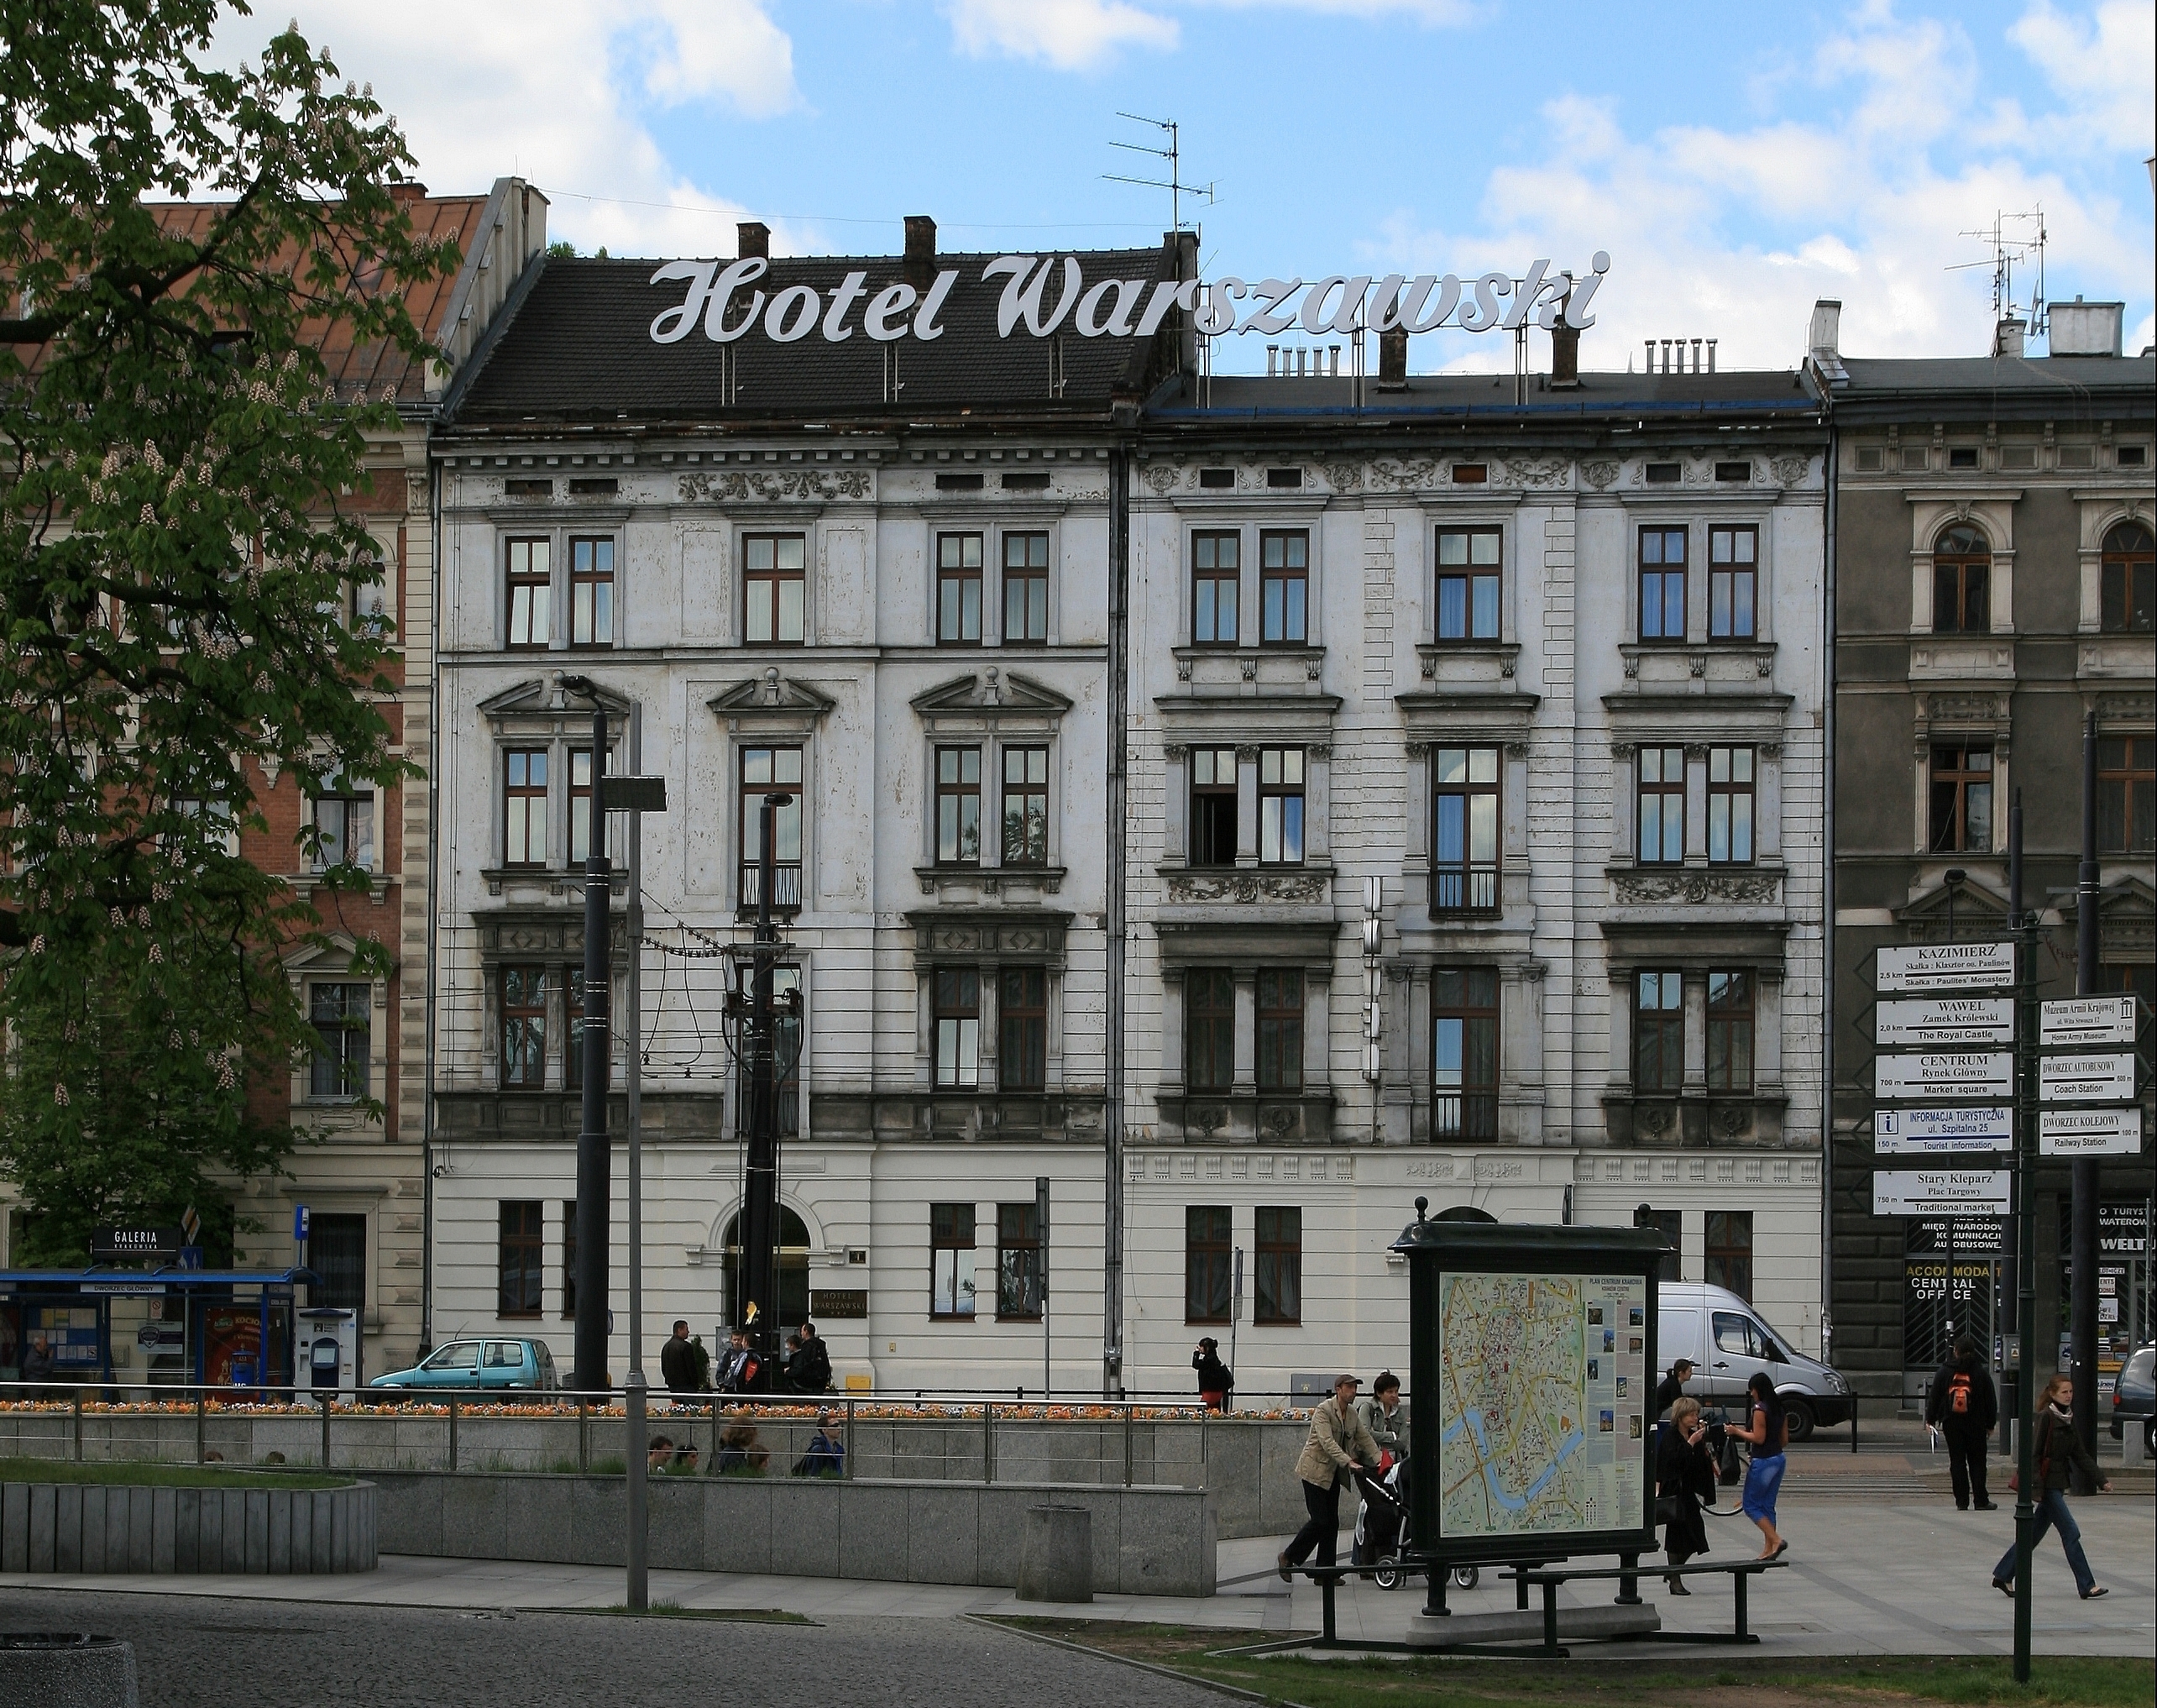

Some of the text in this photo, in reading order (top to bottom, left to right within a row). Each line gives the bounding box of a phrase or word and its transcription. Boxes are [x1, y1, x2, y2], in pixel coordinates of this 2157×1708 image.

[650, 249, 1610, 342] Hotel Warszawski
[1919, 946, 1997, 959] KAZIMIERZ
[1971, 976, 2010, 984] Monastery
[1938, 1001, 1986, 1011] WAWEL
[1922, 1013, 1998, 1023] Zamek Królewski
[1919, 1030, 1993, 1040] The Royal Castle
[1920, 1056, 1988, 1066] CENTRUM
[2044, 1061, 2115, 1073] DWORZEC AUTOBUSOWY
[1922, 1068, 1950, 1079] Rynek
[1958, 1086, 1987, 1095] square
[2055, 1083, 2103, 1093] Coach Station
[1910, 1109, 2005, 1123] INFORMACJA TURYSTYCZNA
[2044, 1116, 2120, 1128] DWORZEC KOLEJOWY
[1928, 1124, 1988, 1134] ul. Szpitalna 25
[2055, 1138, 2107, 1148] Railway Station
[1918, 1173, 1992, 1186] Stary Kleparz
[1946, 1187, 1982, 1197] Targowy
[1915, 1203, 1995, 1212] Traditional market
[114, 1231, 157, 1243] GALERIA
[1916, 1290, 1971, 1299] OFFCE
